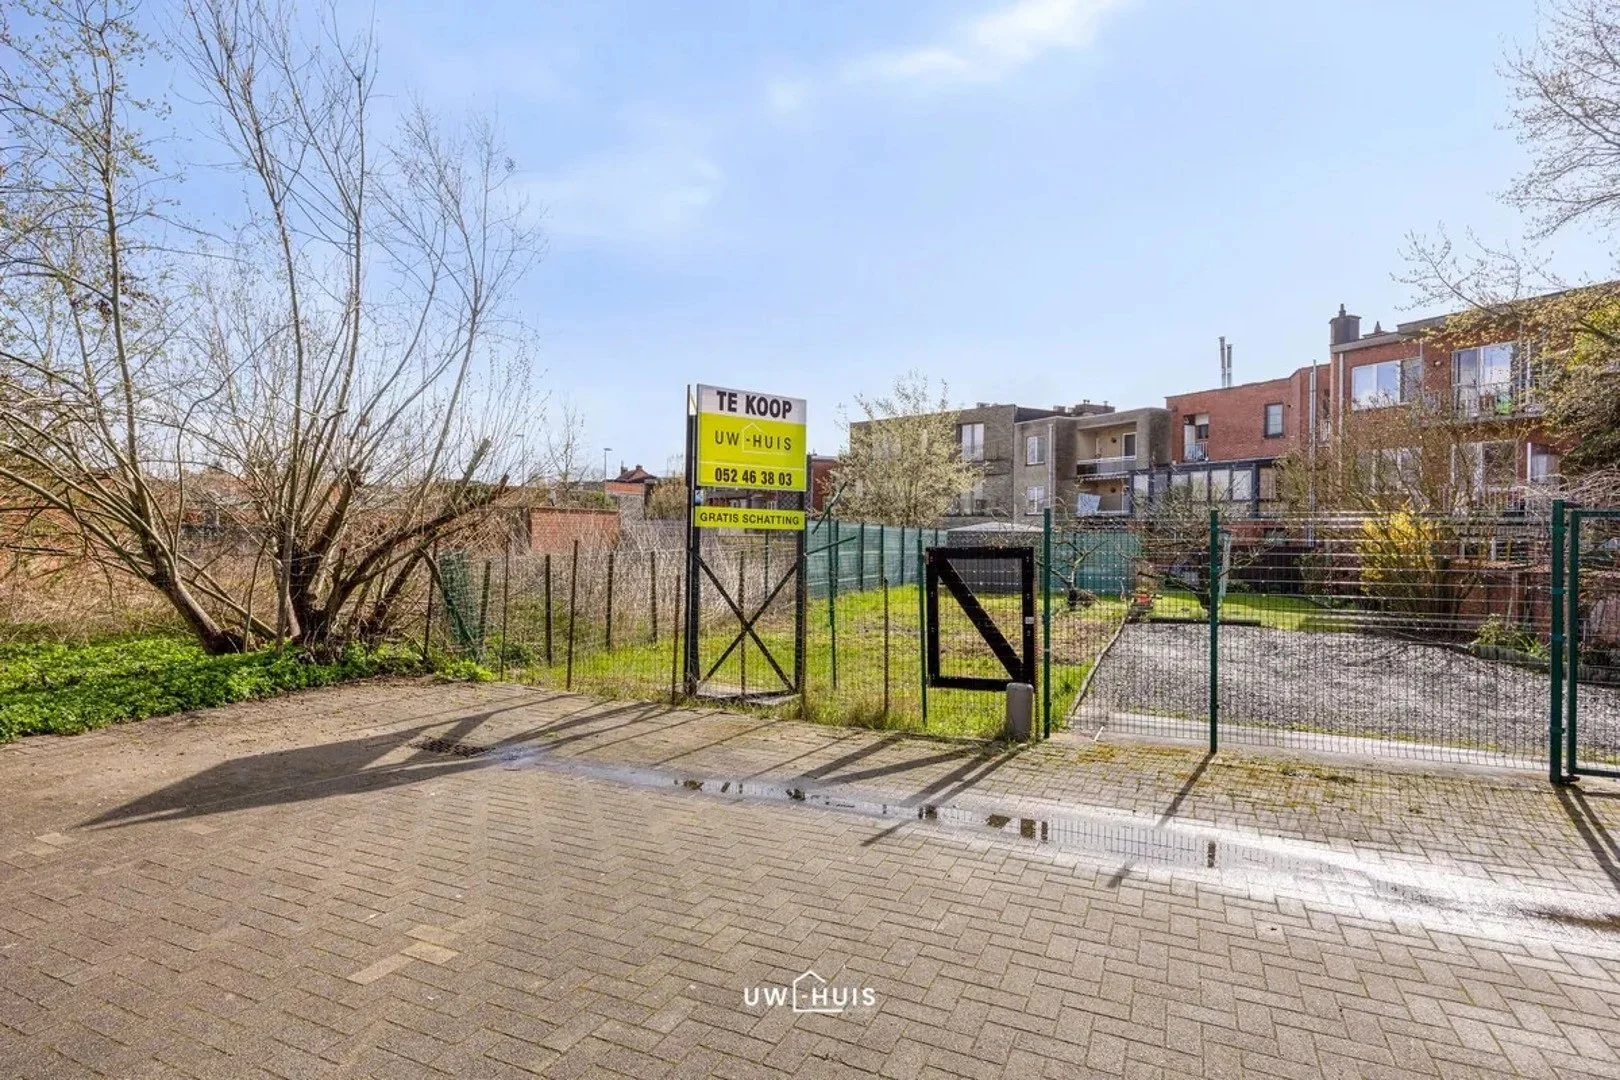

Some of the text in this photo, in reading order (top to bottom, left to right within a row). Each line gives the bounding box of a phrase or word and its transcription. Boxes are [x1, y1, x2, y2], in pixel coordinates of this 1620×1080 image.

[716, 390, 793, 419] TE KOOP
[715, 467, 793, 486] 052 46 38 03
[700, 512, 799, 525] GRATIS SCHATTING
